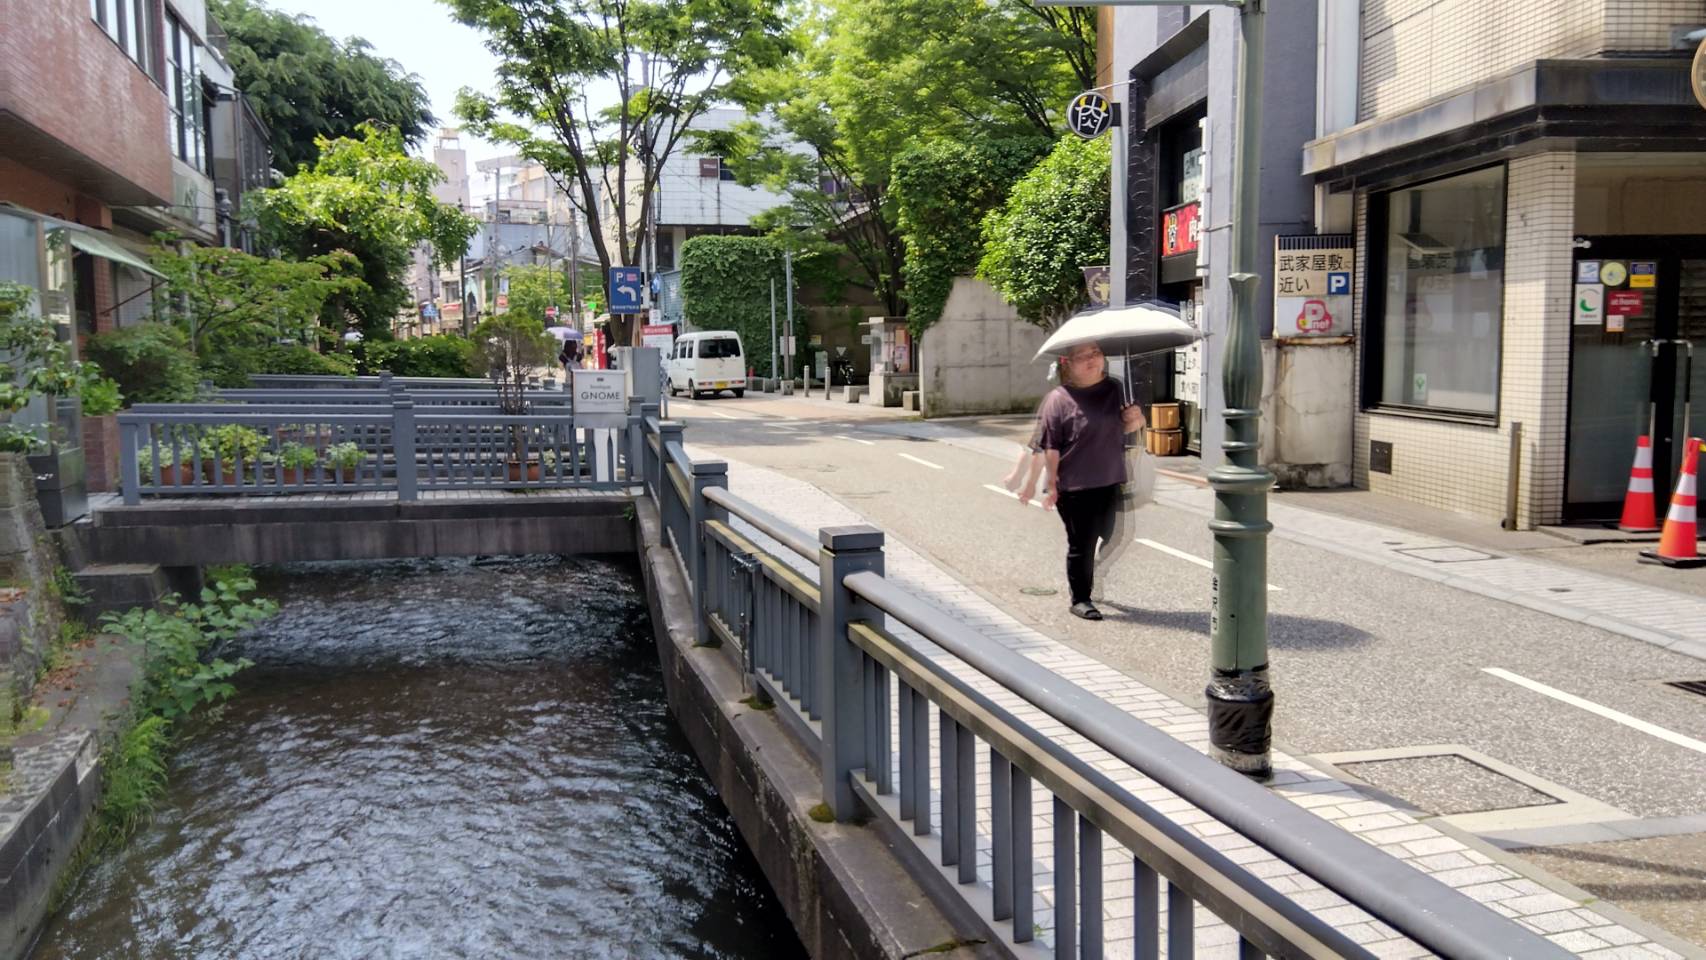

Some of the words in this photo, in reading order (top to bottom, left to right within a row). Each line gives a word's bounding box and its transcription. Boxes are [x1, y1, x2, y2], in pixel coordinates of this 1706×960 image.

[616, 272, 624, 283] P
[1279, 276, 1310, 293] 近い
[1330, 275, 1346, 293] P
[580, 391, 621, 400] GNOME
